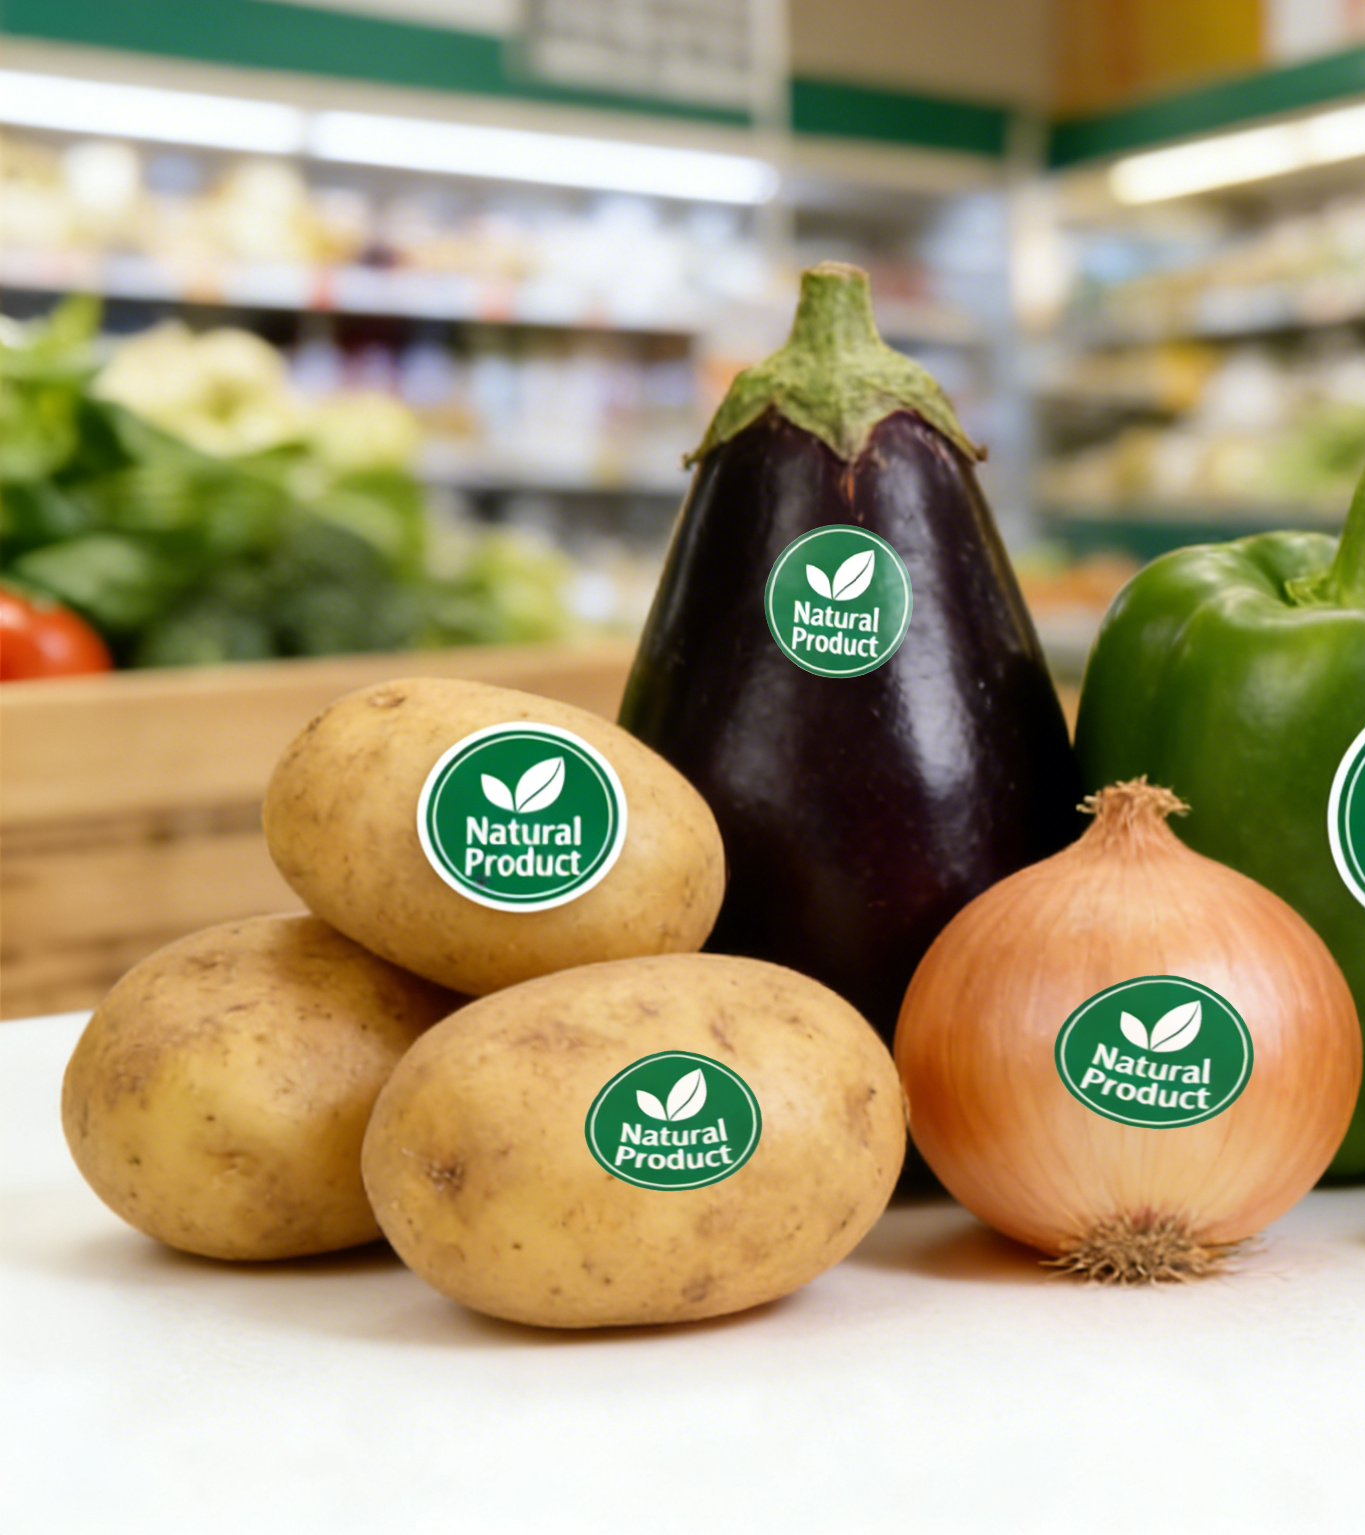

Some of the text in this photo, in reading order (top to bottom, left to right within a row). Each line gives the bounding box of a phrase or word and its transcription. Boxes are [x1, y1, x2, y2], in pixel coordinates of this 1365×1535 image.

[793, 600, 879, 633] Natural
[791, 627, 879, 658] Product
[466, 816, 582, 846] Natural
[464, 845, 582, 877] Product
[1091, 1042, 1211, 1085] Natural
[1079, 1066, 1212, 1110] Product
[619, 1117, 729, 1147] Natural
[614, 1144, 734, 1172] Product
